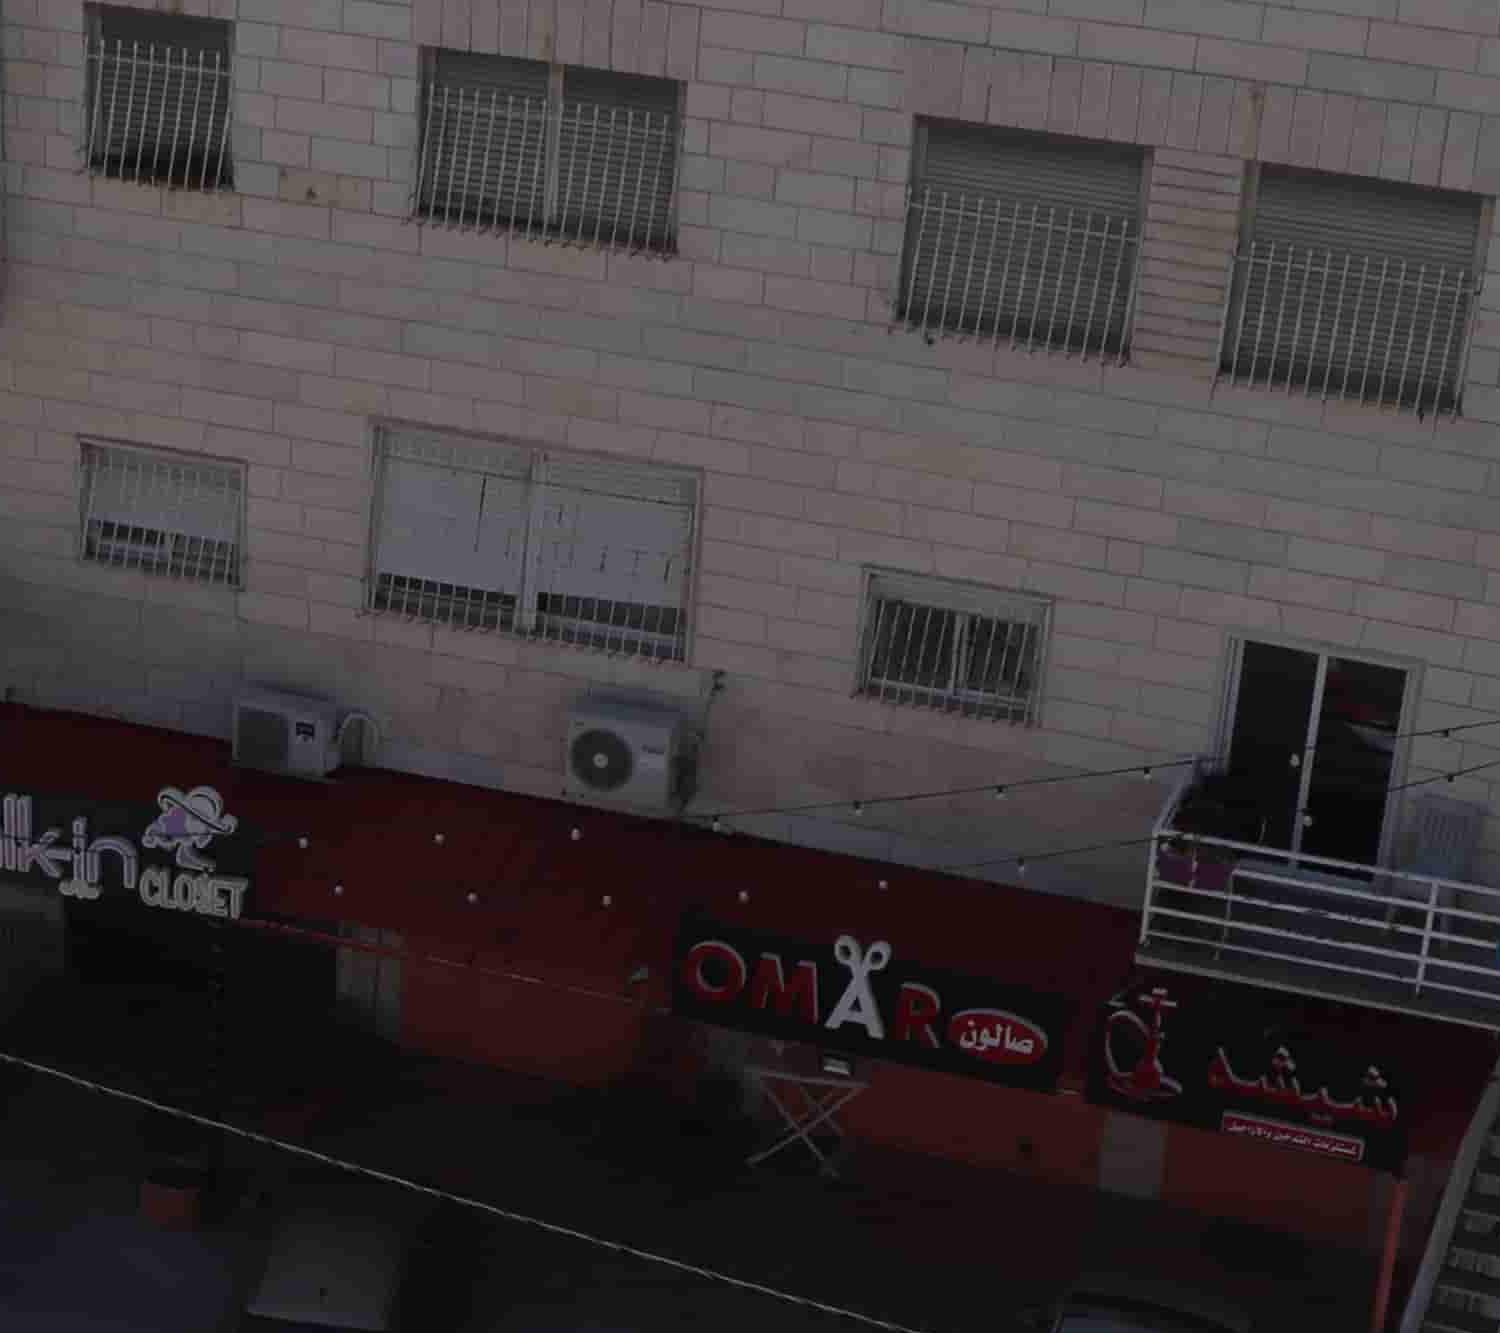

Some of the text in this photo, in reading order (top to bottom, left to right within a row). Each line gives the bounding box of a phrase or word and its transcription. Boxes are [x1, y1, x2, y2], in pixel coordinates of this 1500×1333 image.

[139, 866, 248, 920] CLOSET
[686, 934, 943, 1049] OMAR
[959, 1019, 1035, 1056] صالون
